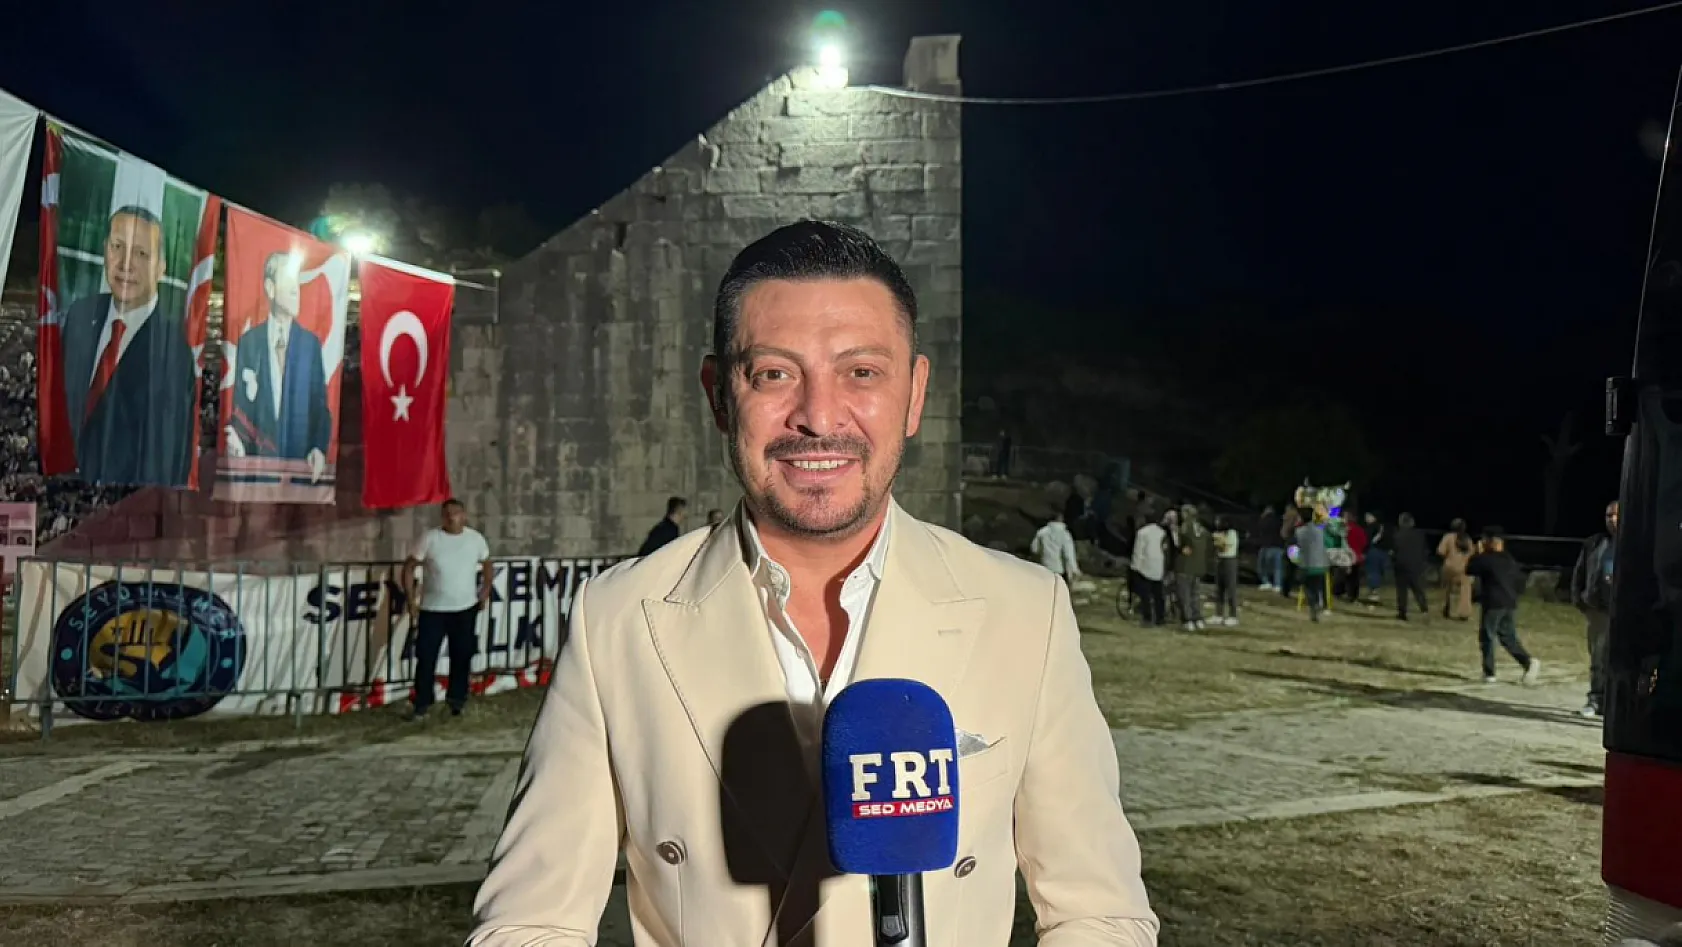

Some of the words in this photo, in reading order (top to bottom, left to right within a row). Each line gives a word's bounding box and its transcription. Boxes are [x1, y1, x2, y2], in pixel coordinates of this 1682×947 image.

[849, 749, 953, 801] FRT
[859, 804, 896, 816] SED
[900, 799, 953, 814] MEDYA
